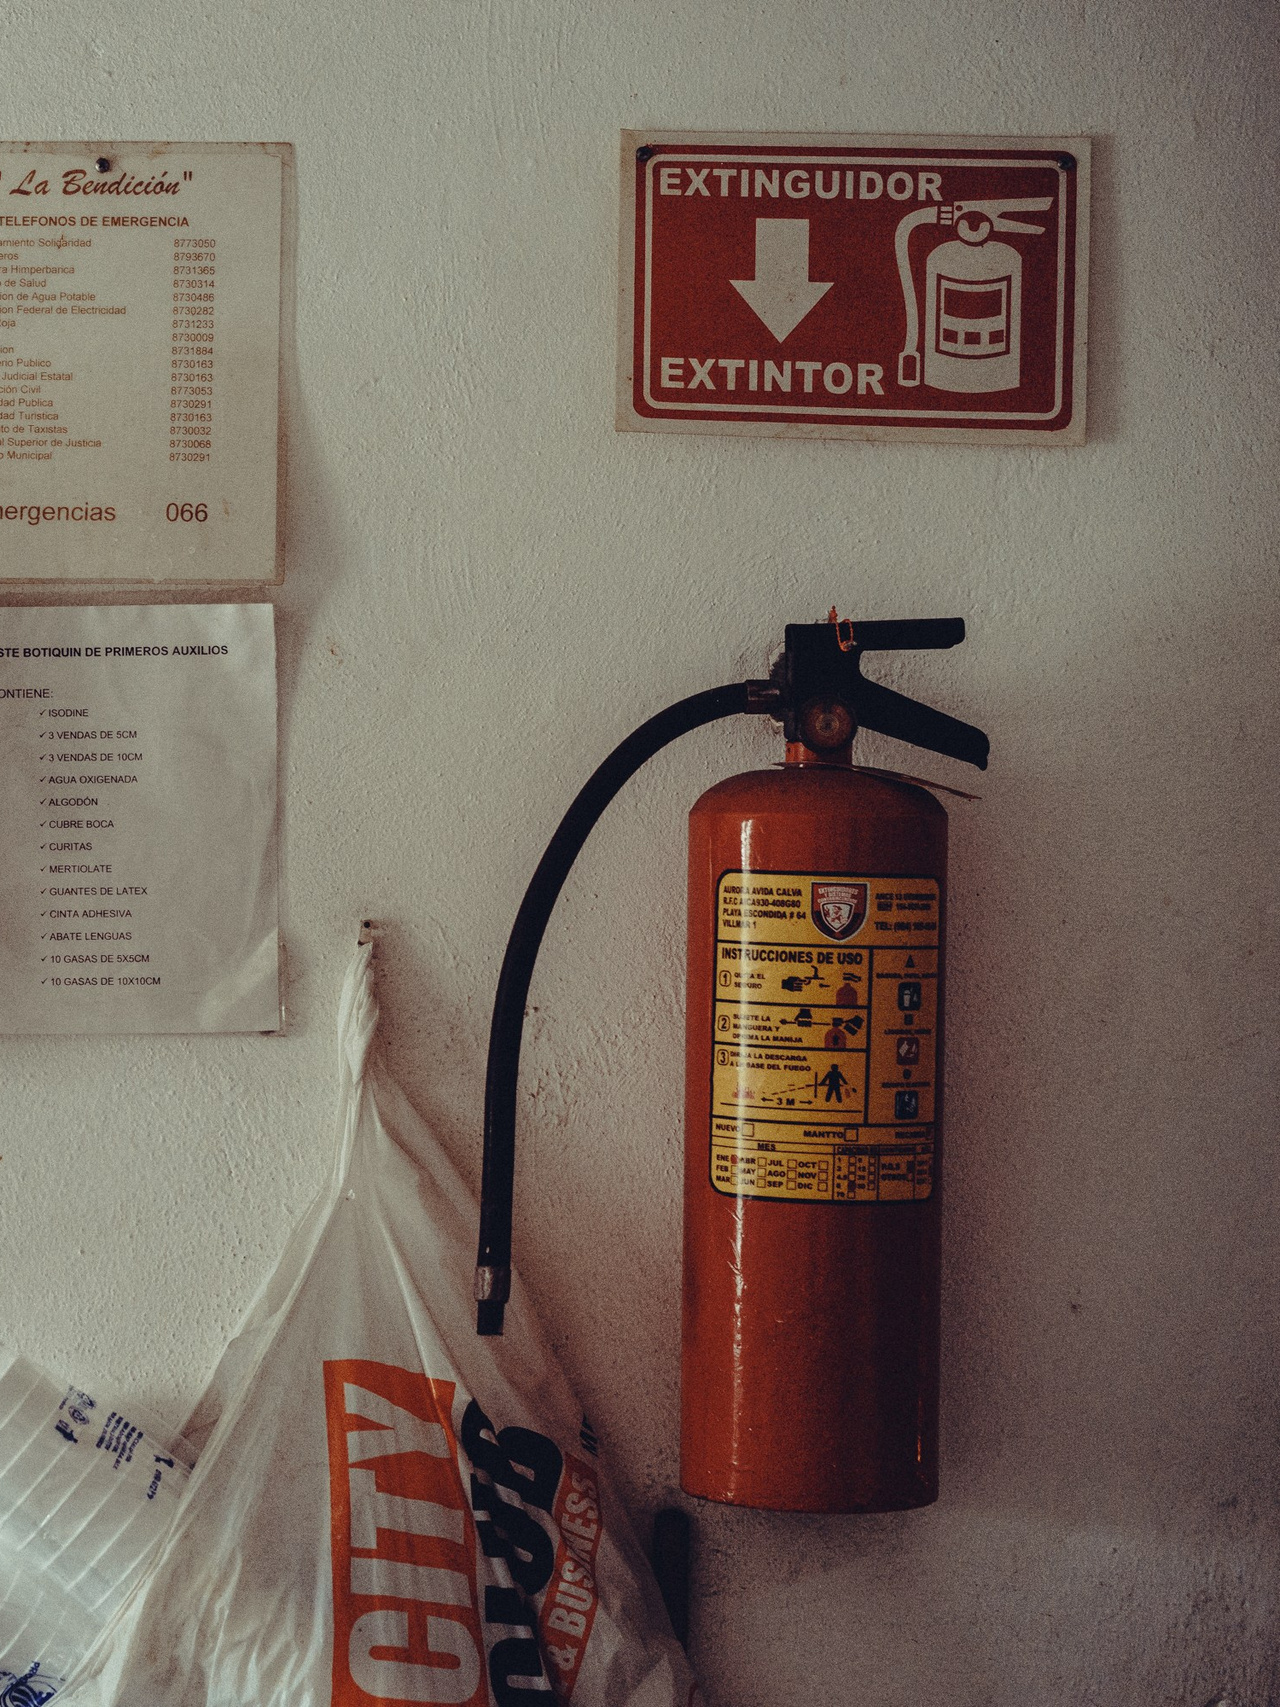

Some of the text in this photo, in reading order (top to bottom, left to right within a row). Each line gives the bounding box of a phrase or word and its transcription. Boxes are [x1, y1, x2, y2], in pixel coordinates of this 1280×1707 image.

[660, 168, 942, 200] EXTINGUIDOR
[81, 216, 97, 226] DE
[103, 216, 189, 227] EMERGENCIA
[174, 239, 215, 248] 8773050
[174, 252, 215, 261] 8793670
[173, 266, 215, 275] 8731365
[5, 279, 16, 288] de
[19, 279, 46, 288] Salud
[173, 279, 215, 288] 8730314
[17, 292, 29, 301] de
[32, 292, 57, 303] Agua
[60, 292, 95, 301] Potable
[173, 293, 214, 302] 8730486
[17, 305, 52, 314] Federal
[56, 306, 68, 315] de
[72, 306, 126, 315] Electricidad
[173, 306, 214, 315] 8730282
[172, 320, 214, 329] 8731233
[172, 333, 213, 342] 8730009
[172, 346, 213, 356] 8731884
[172, 359, 213, 369] 8730163
[2, 372, 37, 381] Judicial
[41, 372, 73, 381] Estatal
[171, 373, 213, 382] 8730163
[661, 357, 884, 395] EXTINTOR
[21, 385, 40, 394] Civil
[171, 386, 212, 395] 8773053
[171, 400, 211, 409] 8730291
[170, 413, 212, 422] 8730163
[13, 425, 24, 434] de
[28, 425, 68, 434] Taxistas
[170, 426, 211, 435] 8730032
[7, 438, 47, 449] Superior
[51, 438, 62, 447] de
[65, 439, 101, 448] Justicia
[170, 440, 211, 449] 8730068
[7, 451, 52, 462] Municipal
[169, 453, 210, 462] 8730291
[166, 503, 208, 522] 066
[23, 647, 81, 658] BOTIQUIN
[85, 647, 101, 657] DE
[105, 646, 168, 657] PRIMEROS
[172, 645, 228, 656] AUXILIOS
[49, 709, 88, 717] ISODINE
[49, 730, 137, 739] 3 VENDAS DE 5CM
[49, 753, 142, 762] 3 VENDAS DE 10CM
[49, 775, 138, 784] AGUA OXIGENADA
[49, 797, 98, 807] ALGODÓN
[49, 820, 114, 829] CUBRE BOCA
[49, 842, 92, 851] CURITAS
[49, 865, 112, 873] MERTIOLATE
[49, 887, 148, 896] GUANTES DE LATEX
[777, 888, 802, 897] CALVA
[49, 910, 132, 919] CINTA ADHESIVA
[49, 932, 132, 941] ABATE LENGUAS
[51, 954, 150, 964] 10 GASAS DE 5X5CM
[722, 947, 863, 965] INSTRUCCIONES DE USO
[51, 976, 161, 986] 10 GASAS DE 10X10CM
[765, 1054, 807, 1062] DESCARGA
[758, 1143, 776, 1151] MES
[717, 1154, 729, 1162] ENE
[768, 1159, 784, 1167] JUL
[798, 1161, 816, 1169] OCT
[768, 1169, 786, 1177] AGO
[767, 1180, 784, 1188] SEP
[343, 1382, 482, 1705] CITY
